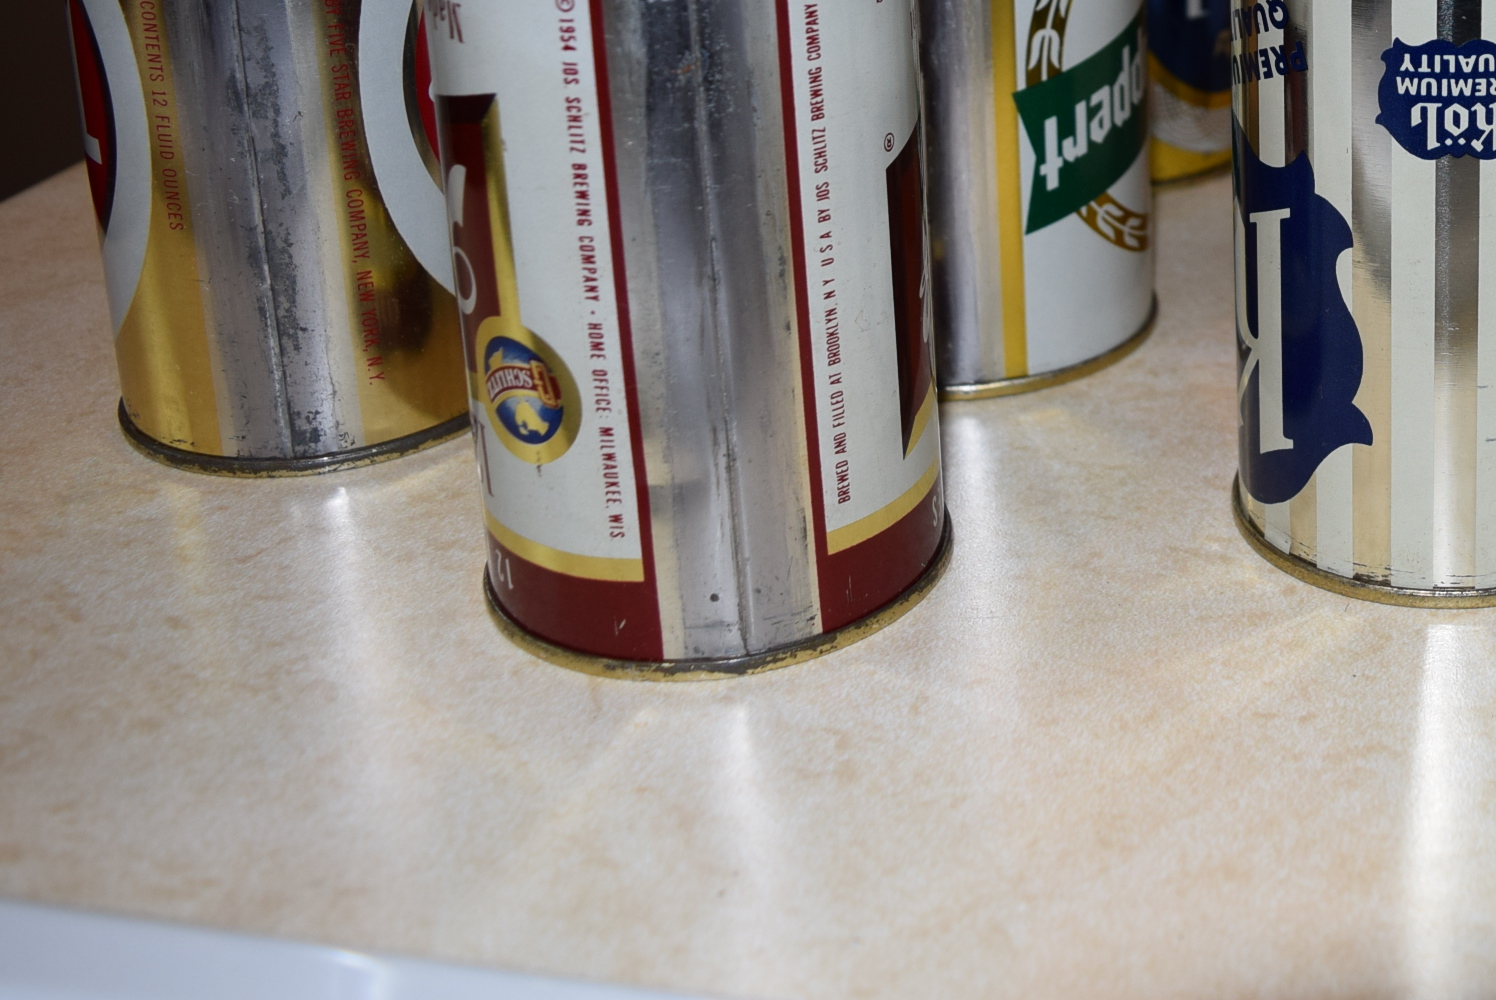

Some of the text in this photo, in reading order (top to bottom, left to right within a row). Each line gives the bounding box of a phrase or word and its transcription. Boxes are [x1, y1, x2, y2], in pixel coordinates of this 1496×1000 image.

[327, 22, 348, 57] FIVE
[331, 63, 351, 100] STAR
[807, 65, 826, 122] BREWING
[140, 1, 184, 232] CONTENTS 12 FLUID OUNCES
[564, 95, 587, 154] SCHLITZ
[336, 108, 361, 181] BREWING
[811, 126, 830, 175] SCHLITZ
[571, 162, 593, 228] BREWING
[345, 189, 371, 264] COMPANY,
[817, 208, 831, 224] BY
[356, 270, 376, 303] NEW
[577, 235, 600, 302] COMPANY
[587, 322, 607, 361] HOME
[365, 355, 386, 386] N.Y.
[828, 372, 843, 386] AT
[830, 389, 846, 429] FILLED
[833, 431, 848, 456] AND
[835, 459, 851, 506] BREWED
[495, 549, 515, 590] 12
